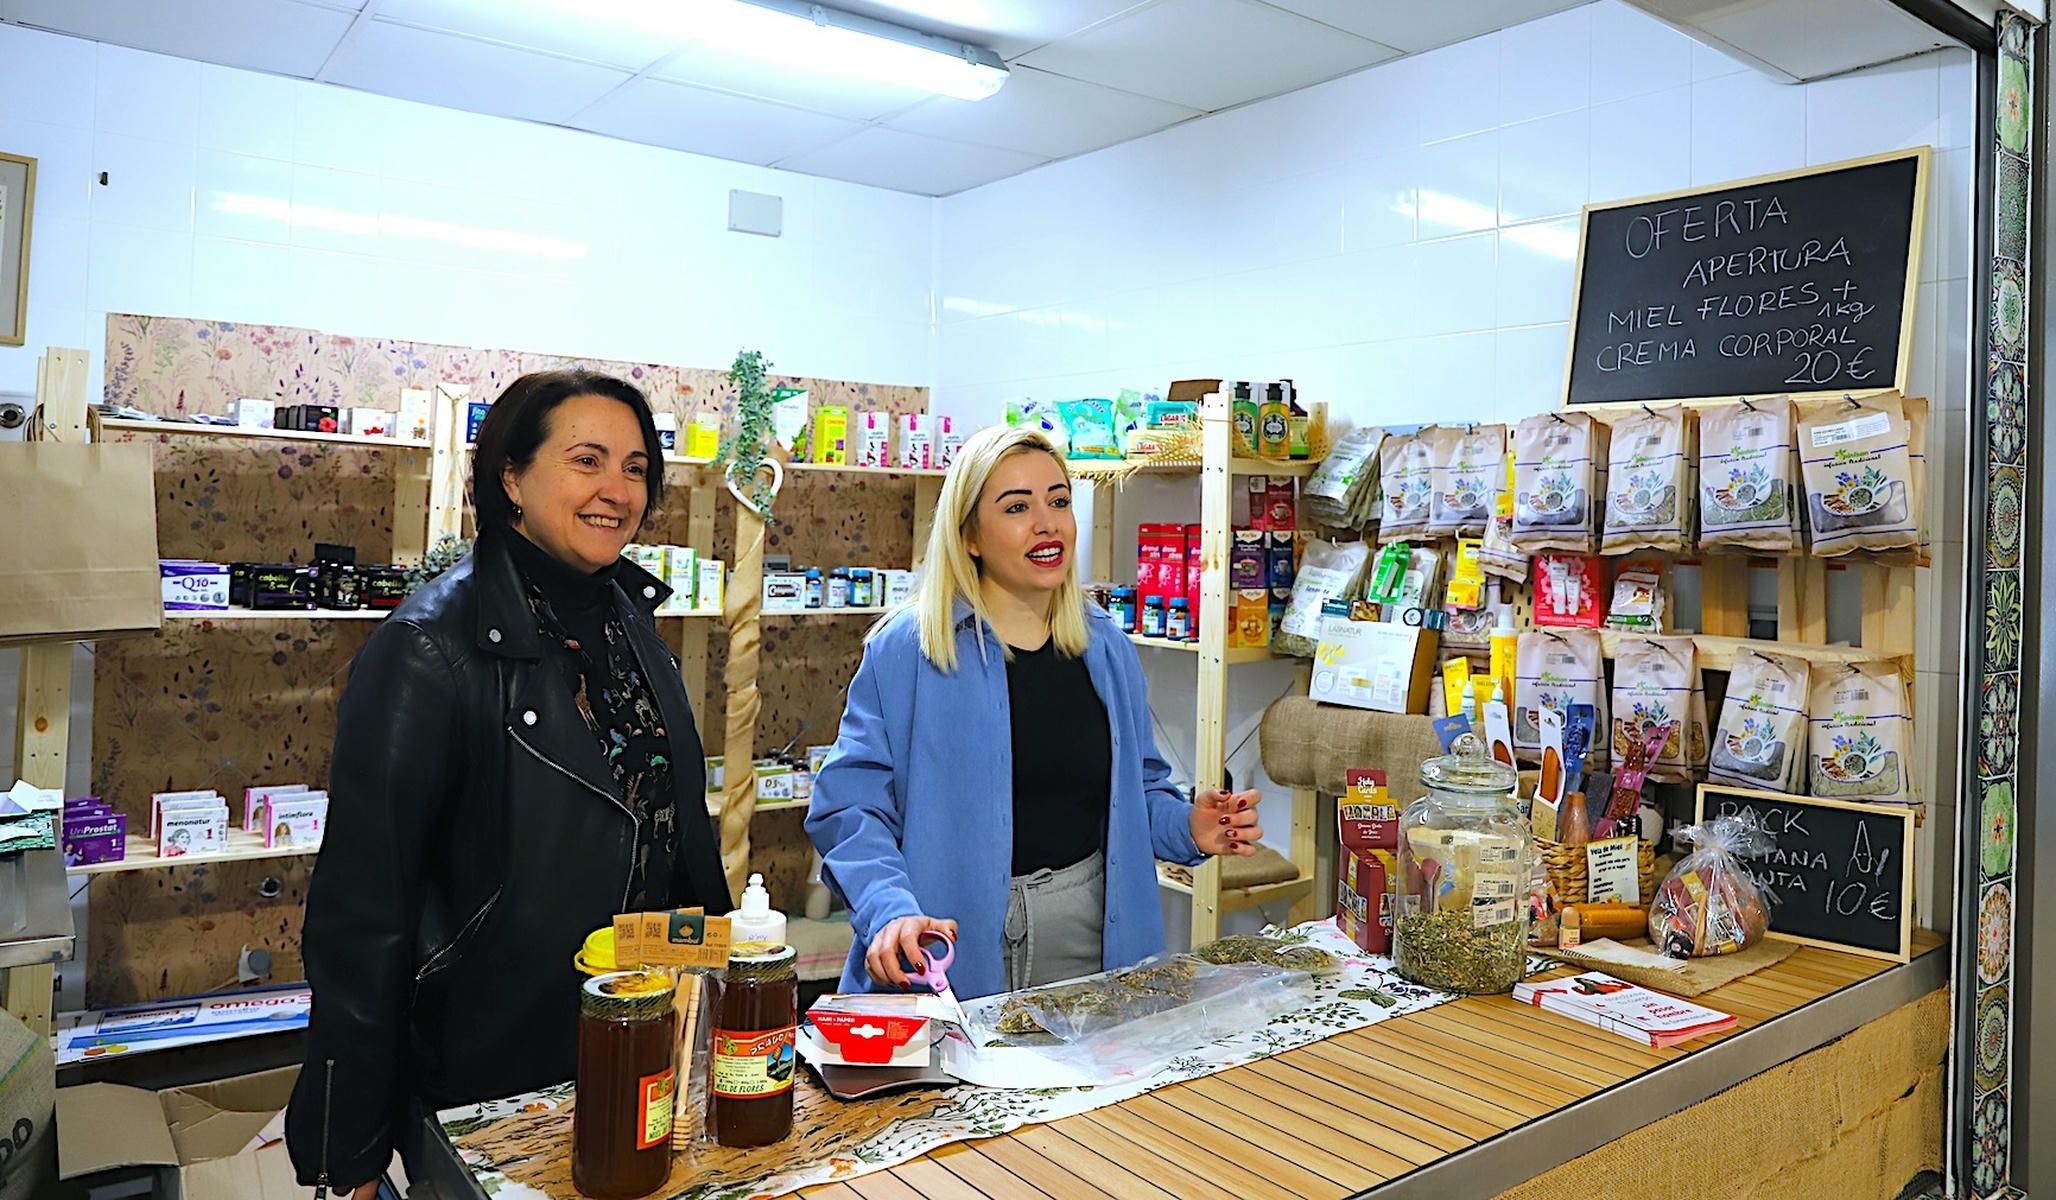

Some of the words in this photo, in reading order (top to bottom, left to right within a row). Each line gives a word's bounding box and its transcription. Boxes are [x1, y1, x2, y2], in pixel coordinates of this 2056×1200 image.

[1626, 197, 1788, 259] OFERTA
[1683, 236, 1851, 288] APERTURA
[1608, 304, 1683, 334] MIEL
[1697, 282, 1819, 321] FLORES
[1597, 338, 1697, 373] CREMA
[1719, 323, 1856, 358] CORPORAL
[182, 577, 209, 593] Q10
